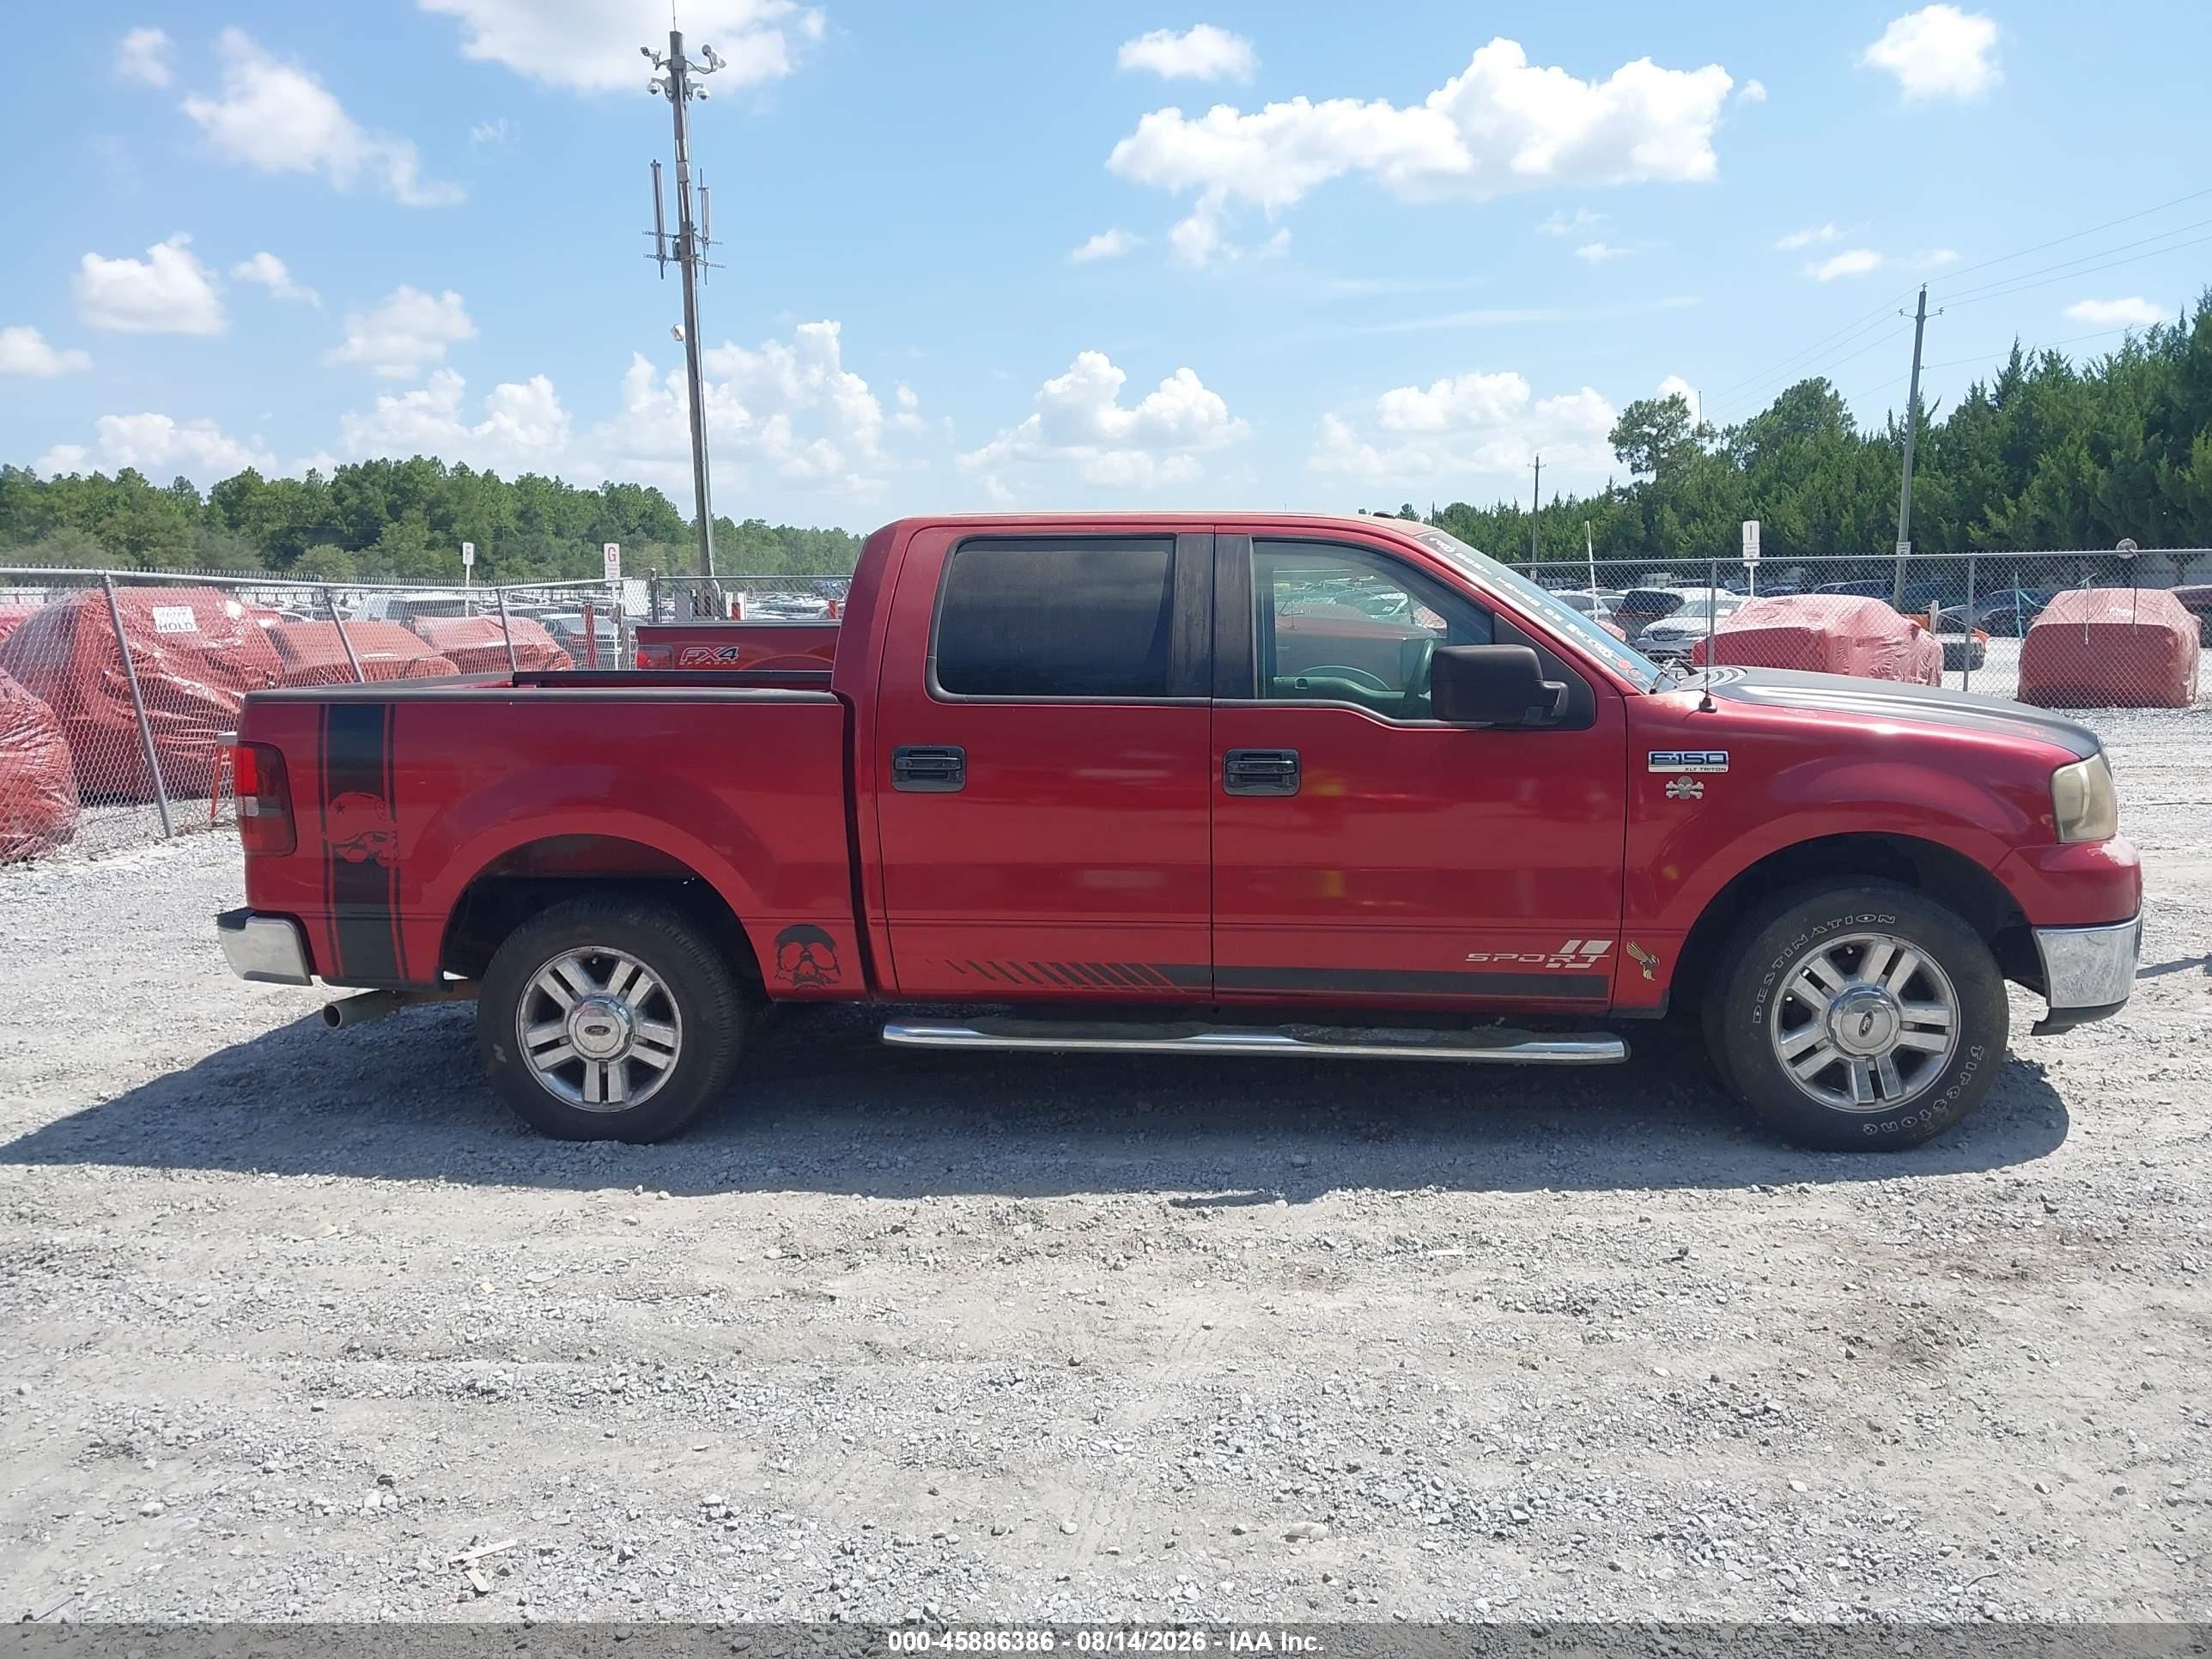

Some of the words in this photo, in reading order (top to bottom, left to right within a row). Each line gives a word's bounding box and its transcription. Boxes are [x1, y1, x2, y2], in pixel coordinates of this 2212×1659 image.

[607, 546, 617, 562] G
[159, 622, 193, 631] HOLD
[680, 647, 739, 662] FX4
[1465, 952, 1611, 963] SPORT
[1752, 914, 1896, 1024] DESTINATION
